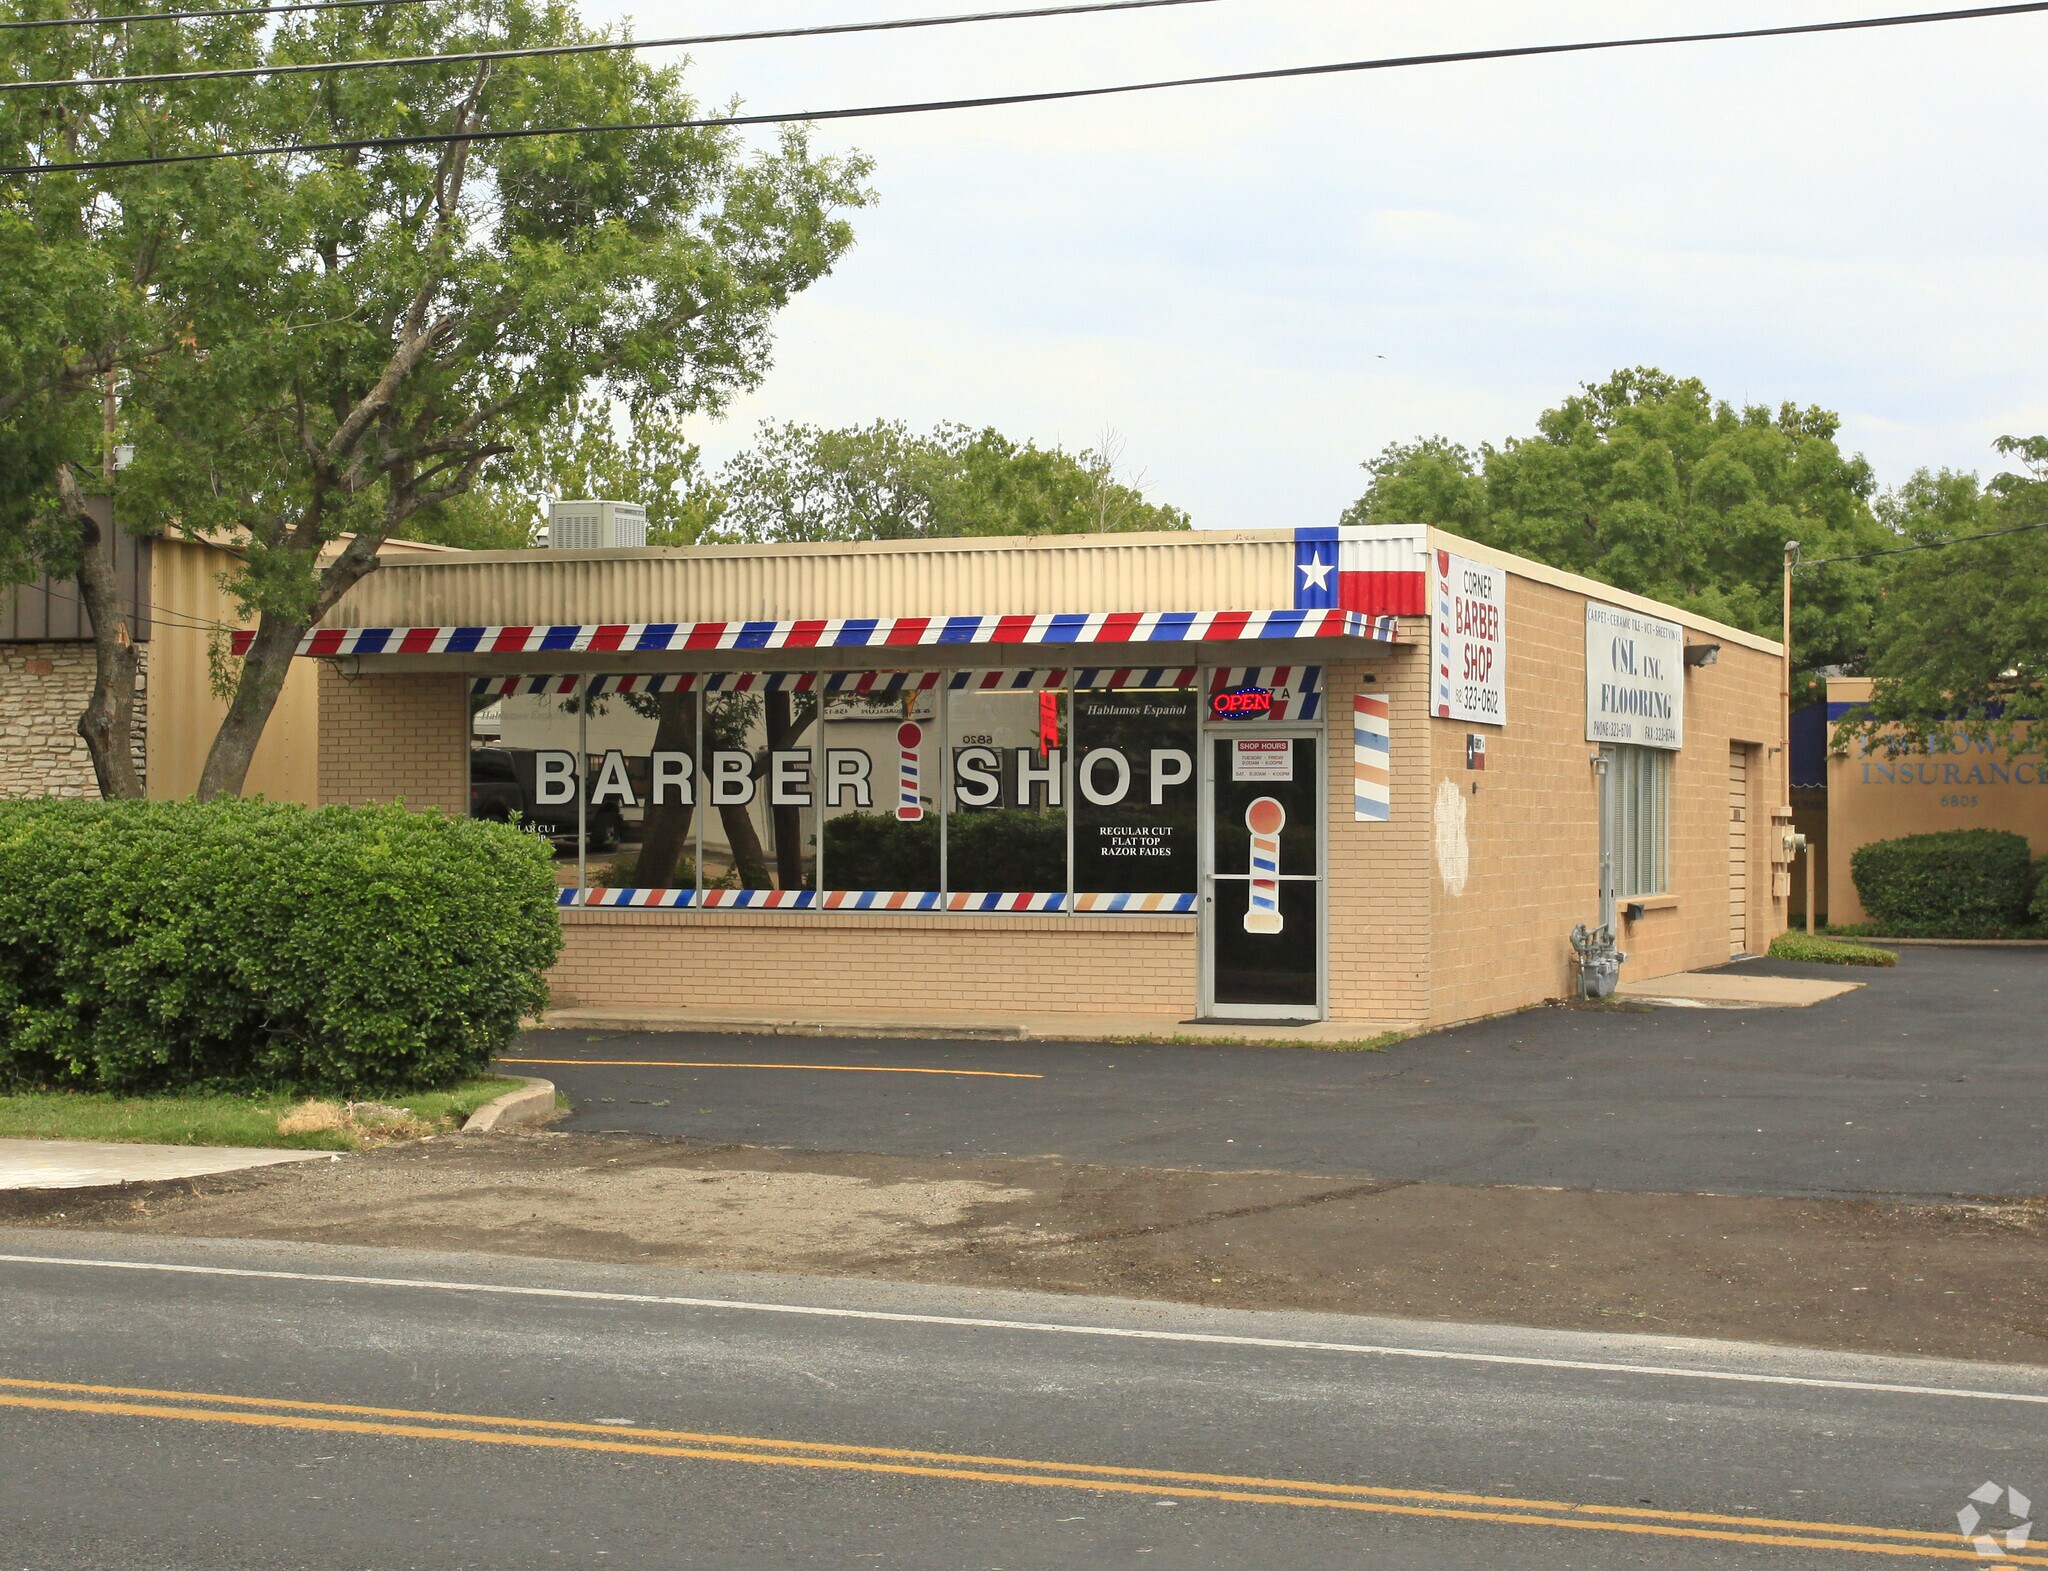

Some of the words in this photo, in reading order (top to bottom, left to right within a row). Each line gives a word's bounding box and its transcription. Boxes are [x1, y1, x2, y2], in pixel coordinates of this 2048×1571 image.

[1463, 570, 1493, 600] CORNER
[1455, 596, 1499, 643] BARBER
[1463, 642, 1493, 684] SHOP
[1644, 656, 1663, 680] INC.
[1213, 693, 1271, 711] OPEN
[1281, 687, 1290, 699] A
[1464, 685, 1499, 715] 323-0602
[1601, 683, 1671, 720] FLOORING
[1087, 705, 1140, 715] Hablamos
[1143, 704, 1187, 717] Español
[534, 749, 872, 806] BARBER
[954, 747, 1193, 807] SHOP
[537, 825, 557, 833] CUT
[1100, 827, 1149, 836] REGULAR
[1151, 827, 1173, 836] CUT
[1101, 847, 1137, 856] RAZOR
[1139, 847, 1171, 856] FADES
[1112, 837, 1138, 846] FLAT
[1140, 837, 1160, 846] TOP
